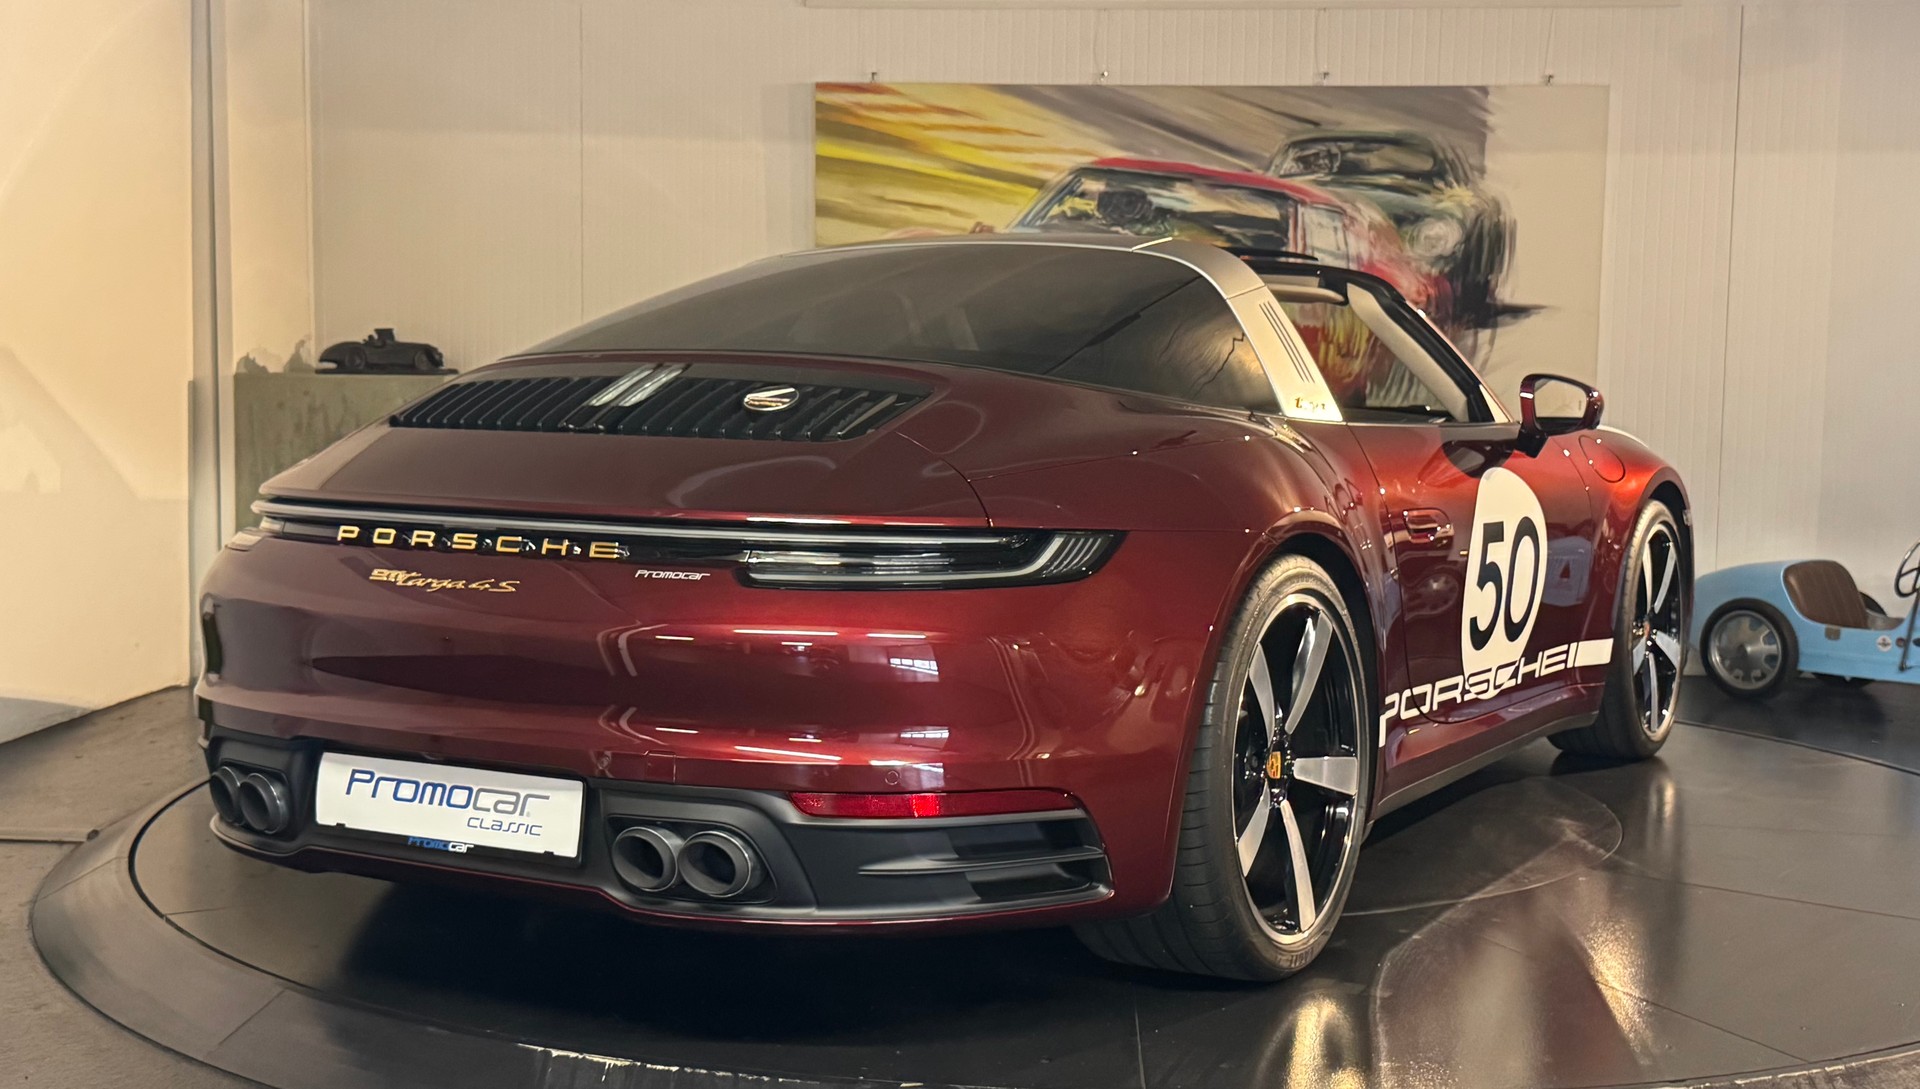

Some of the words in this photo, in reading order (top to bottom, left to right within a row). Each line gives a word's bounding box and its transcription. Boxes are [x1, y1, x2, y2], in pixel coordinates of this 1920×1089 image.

[337, 525, 620, 560] PORSCHE
[1469, 516, 1541, 652] 50
[1379, 642, 1570, 748] PORSCHE
[345, 768, 551, 817] Promocar
